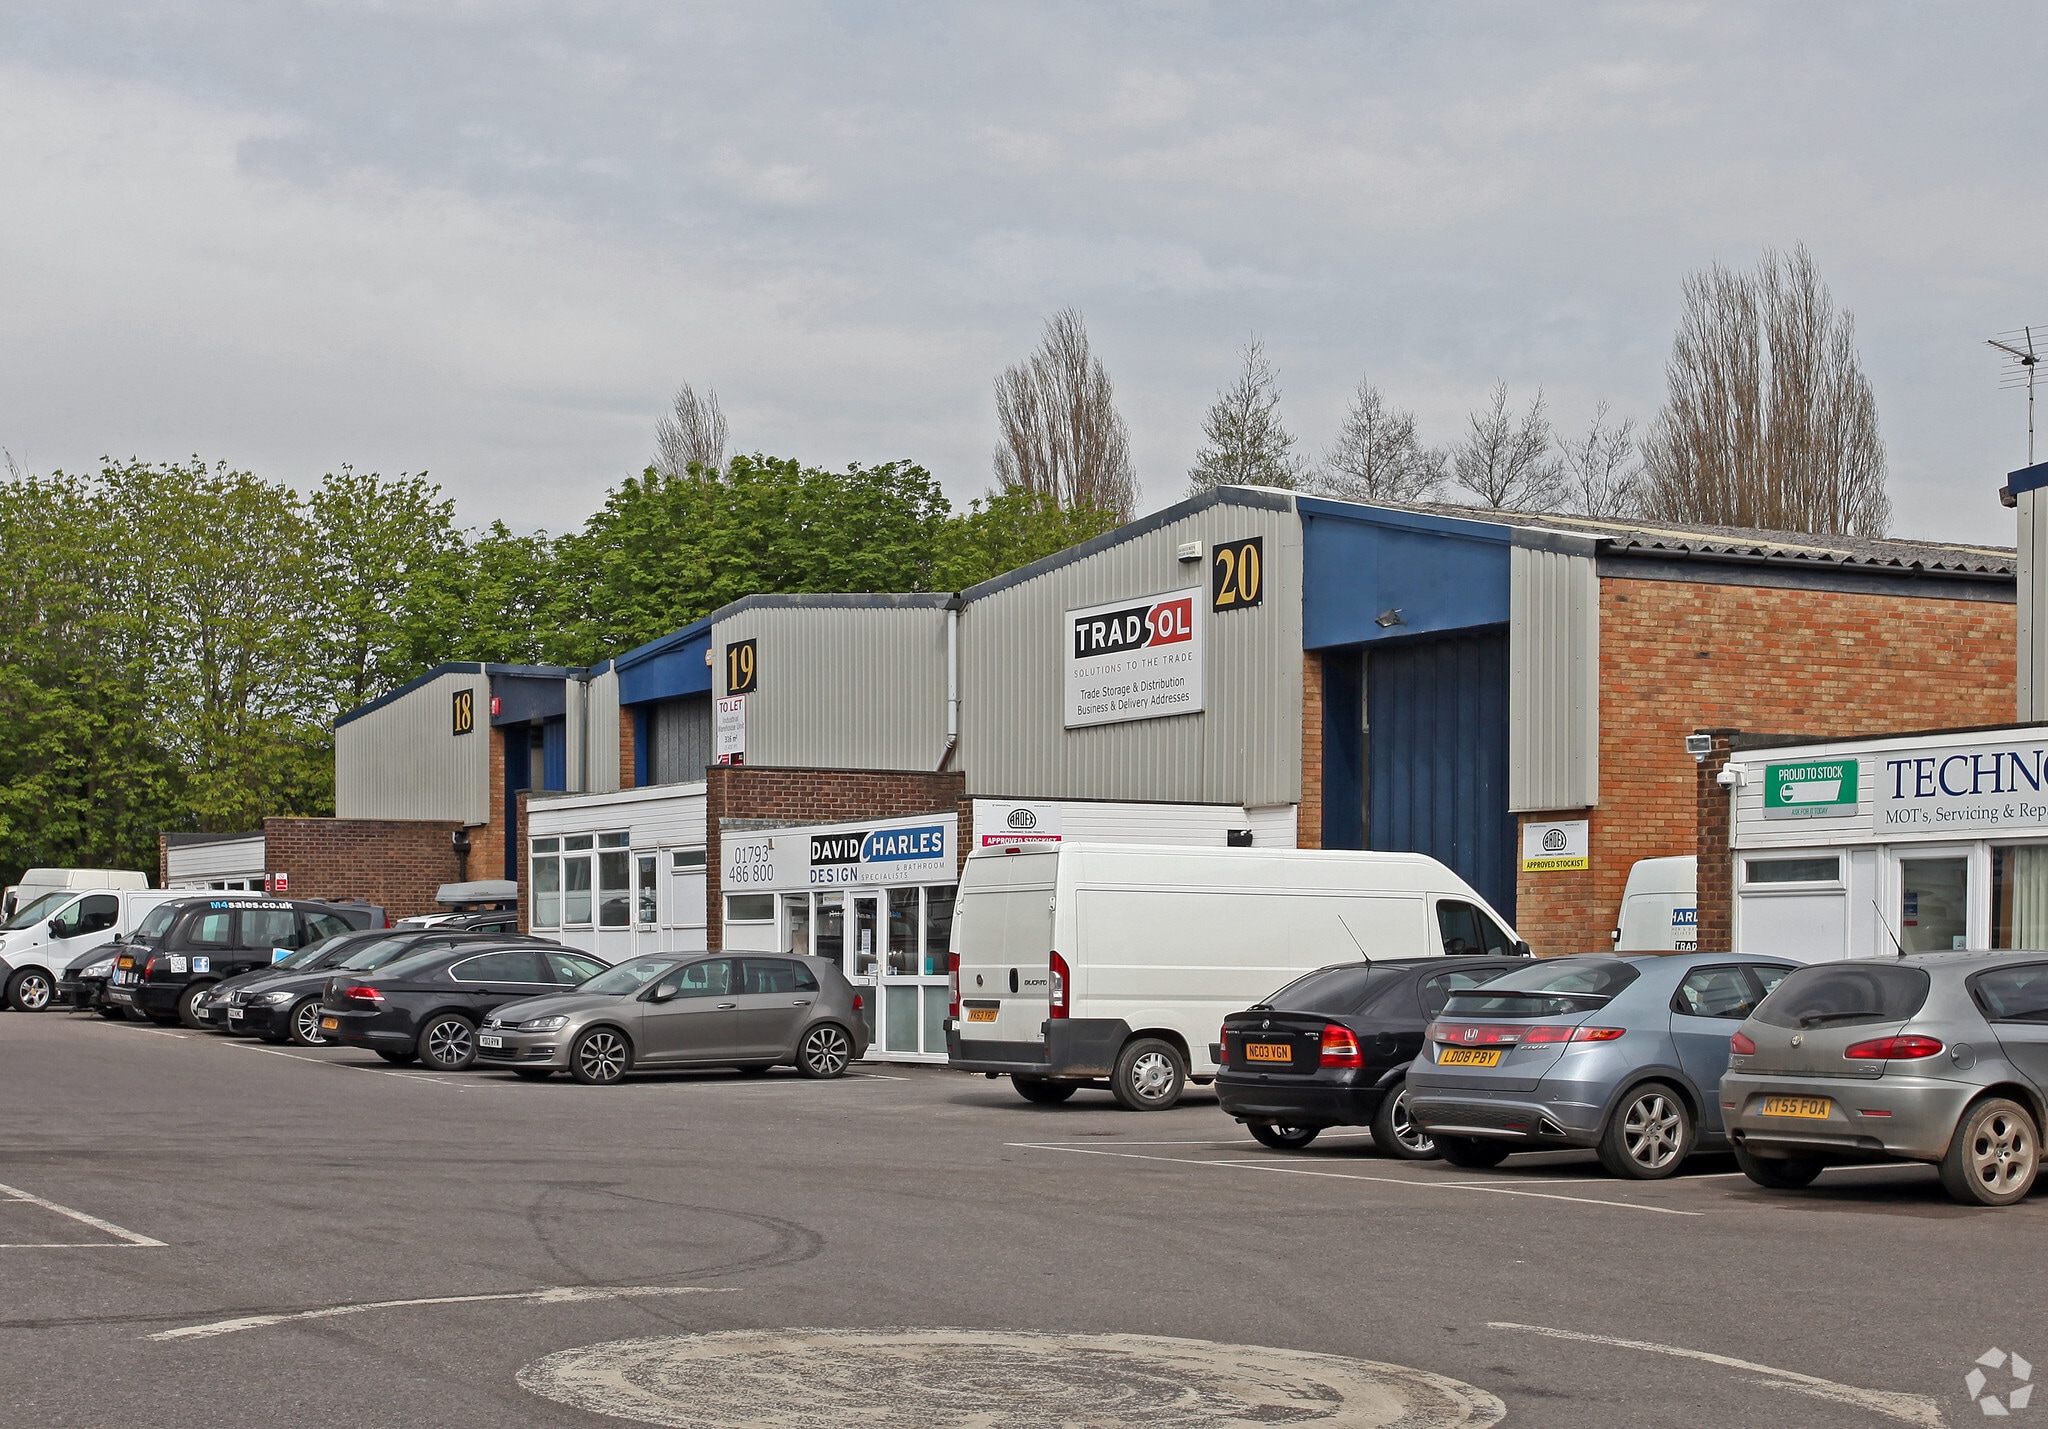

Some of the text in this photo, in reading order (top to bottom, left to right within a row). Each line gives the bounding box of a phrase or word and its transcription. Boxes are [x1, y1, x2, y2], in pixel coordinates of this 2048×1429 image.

[1215, 544, 1260, 605] 20
[1076, 602, 1191, 651] TRADSOL
[729, 645, 754, 690] 19
[1074, 651, 1193, 678] SOLUTIONS TO THE TRADE
[1080, 677, 1185, 700] Trade Storage & Distribution
[454, 693, 471, 731] 18
[719, 700, 743, 713] TO LET
[1077, 692, 1190, 715] Business & Delivery Addresses
[1779, 765, 1843, 781] PROUD TO STOCK
[1887, 749, 2048, 799] TECHN
[1885, 802, 2048, 824] MOT's, Servicing & Rep
[734, 845, 769, 864] 01793
[811, 831, 943, 863] DAVID CHARLES
[903, 862, 945, 870] BATHROOM
[1527, 859, 1584, 868] APPROVED STOCKIST
[729, 864, 774, 883] 486 800
[810, 866, 908, 883] DESIGN SPECIALISTS
[210, 901, 293, 910] M4sales.co.uk
[1676, 941, 1698, 951] TRAD
[1271, 1046, 1288, 1058] VGN
[1444, 1051, 1496, 1064] LD08 PBY
[1765, 1098, 1826, 1115] KT55 FOA
